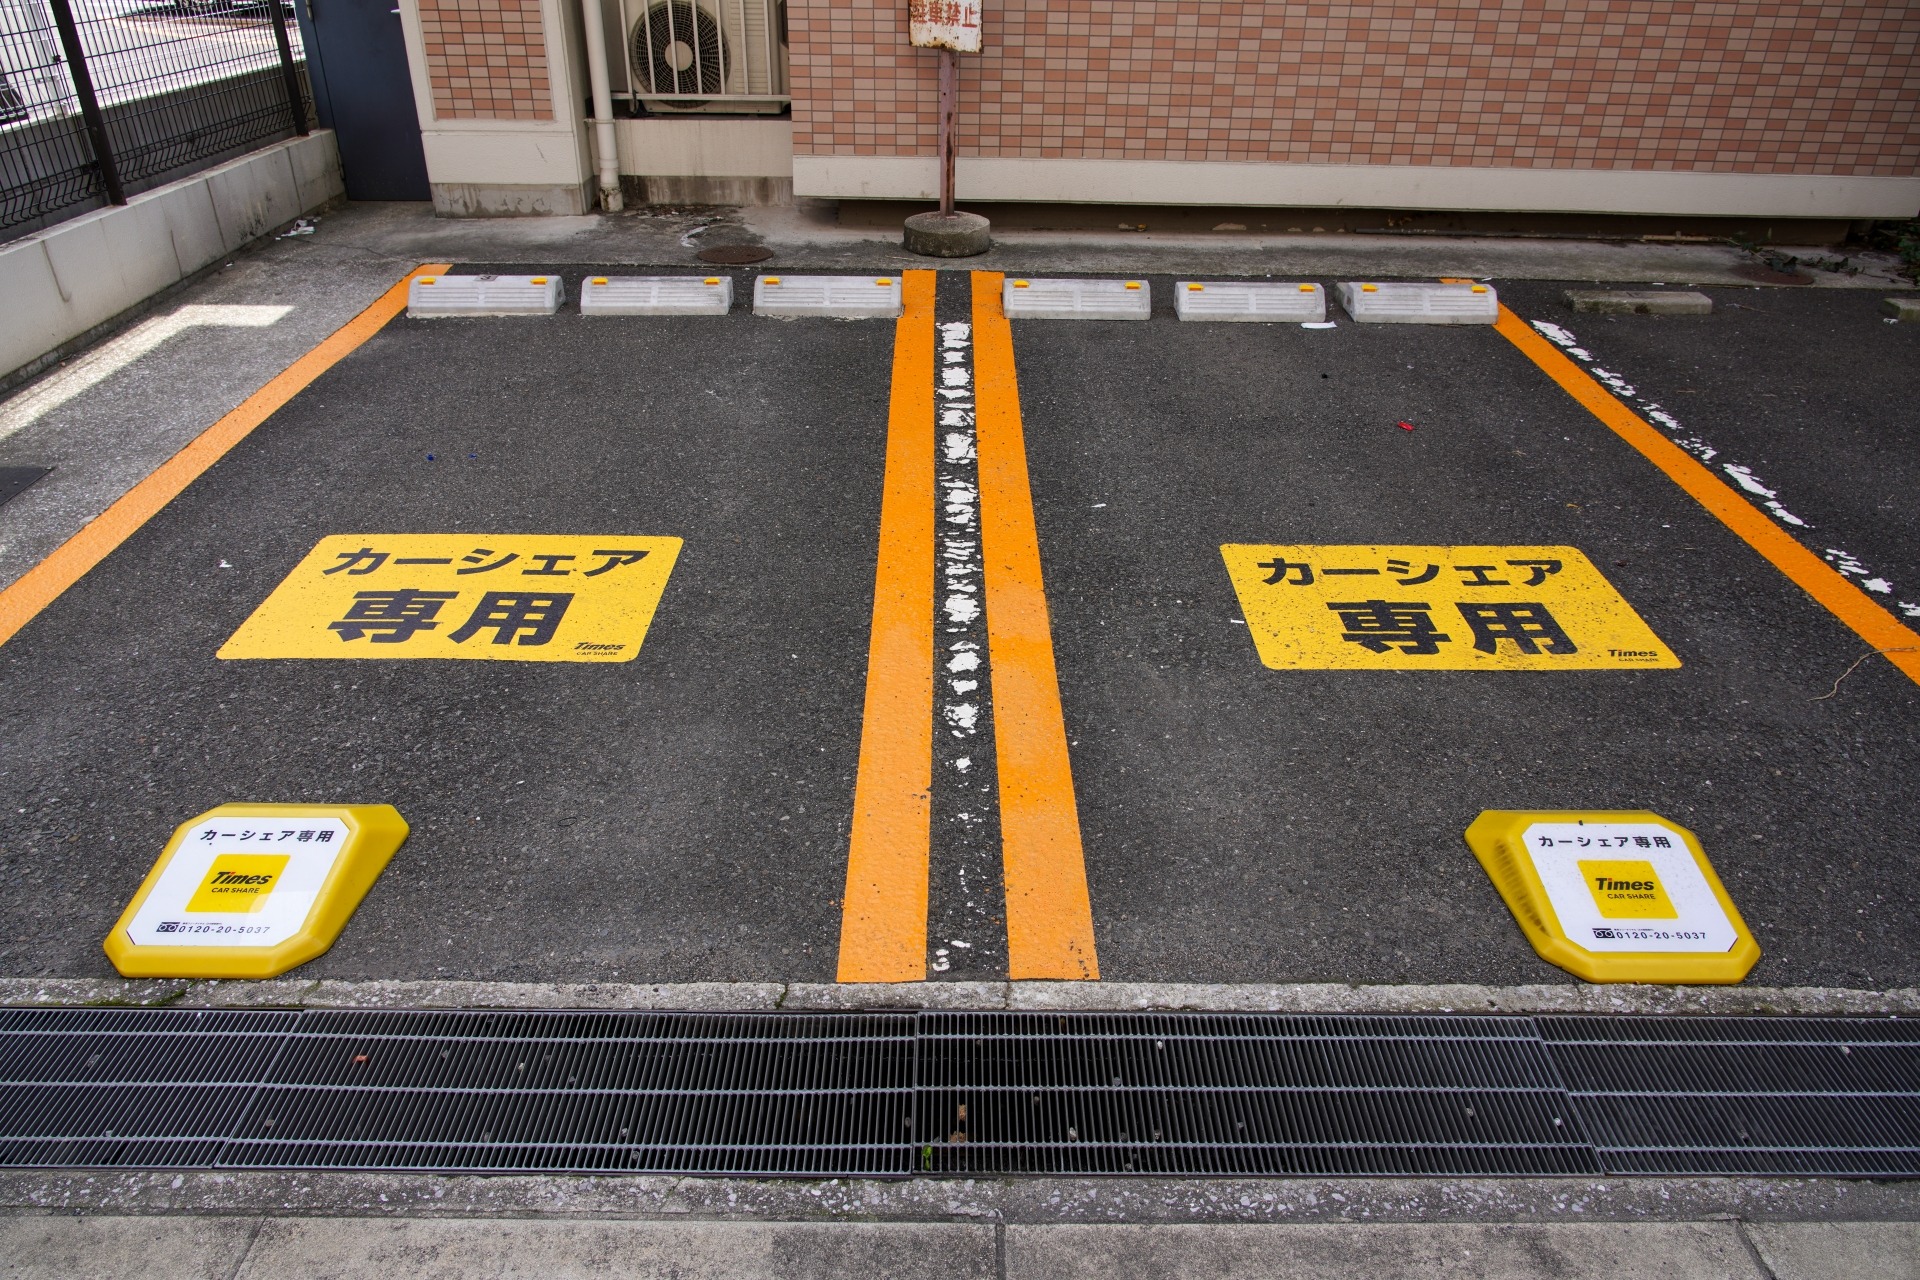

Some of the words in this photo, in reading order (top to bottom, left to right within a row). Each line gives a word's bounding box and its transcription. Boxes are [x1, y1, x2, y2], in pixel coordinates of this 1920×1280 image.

[322, 547, 650, 578] カーシェア
[1257, 557, 1562, 587] カーシェア
[327, 588, 576, 647] 専用
[1326, 599, 1579, 655] 専用
[574, 642, 626, 650] Times
[1607, 649, 1658, 657] Times
[200, 829, 334, 843] カーシェア専用
[1538, 836, 1672, 849] カーシェア専用
[210, 871, 273, 885] Times
[1595, 877, 1655, 891] Times
[178, 925, 271, 934] 0120-20-5037
[1616, 931, 1706, 940] 0120-20-5037
